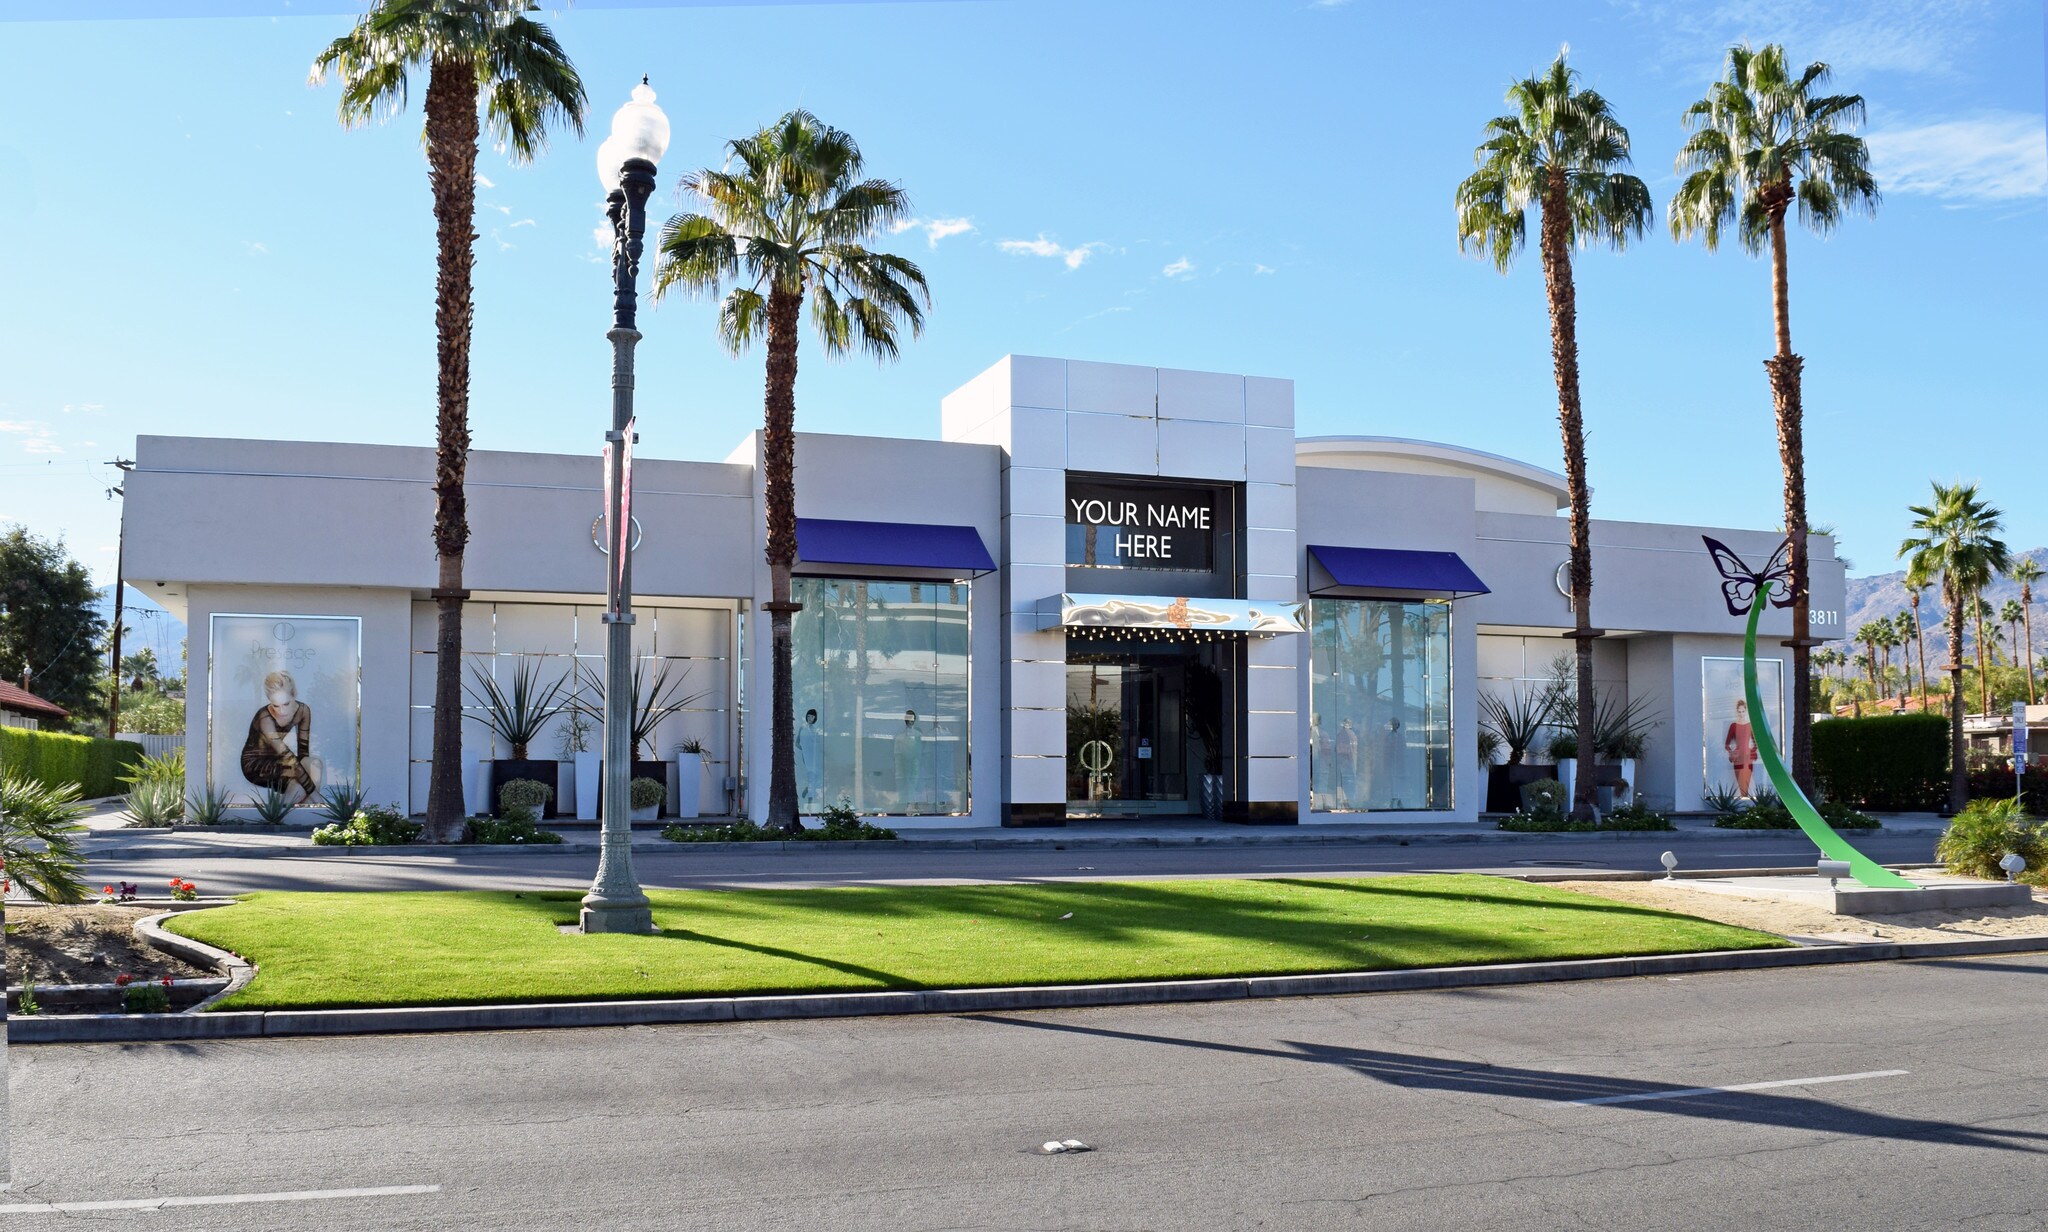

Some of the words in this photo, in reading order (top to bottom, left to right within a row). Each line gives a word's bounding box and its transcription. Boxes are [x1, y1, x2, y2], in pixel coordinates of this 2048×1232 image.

[1071, 498, 1140, 526] YOUR
[1147, 503, 1210, 530] NAME
[1115, 533, 1172, 559] HERE
[1808, 609, 1838, 625] 3811
